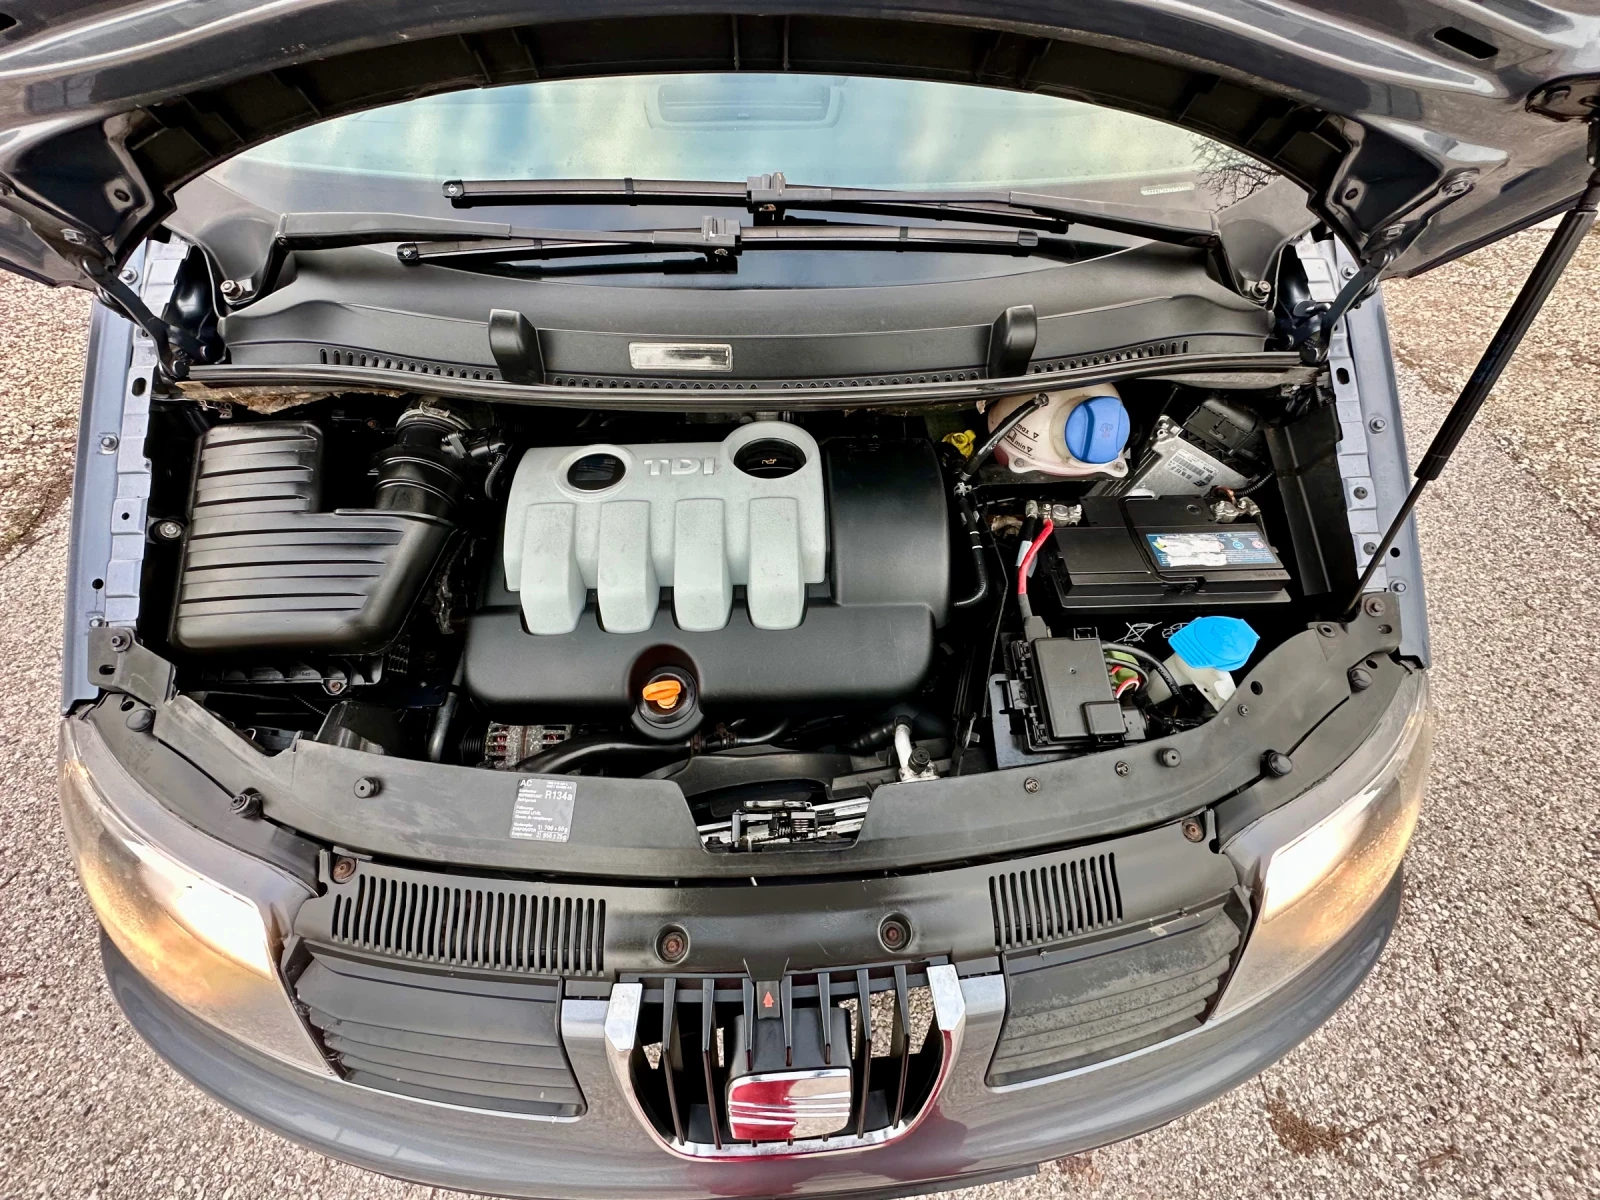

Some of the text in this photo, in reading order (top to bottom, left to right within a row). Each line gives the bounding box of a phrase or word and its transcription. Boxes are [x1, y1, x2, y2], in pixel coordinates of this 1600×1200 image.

[1016, 423, 1030, 435] max
[1014, 440, 1026, 450] min
[643, 457, 715, 476] TDI
[520, 779, 533, 787] AC
[545, 790, 573, 801] R134a
